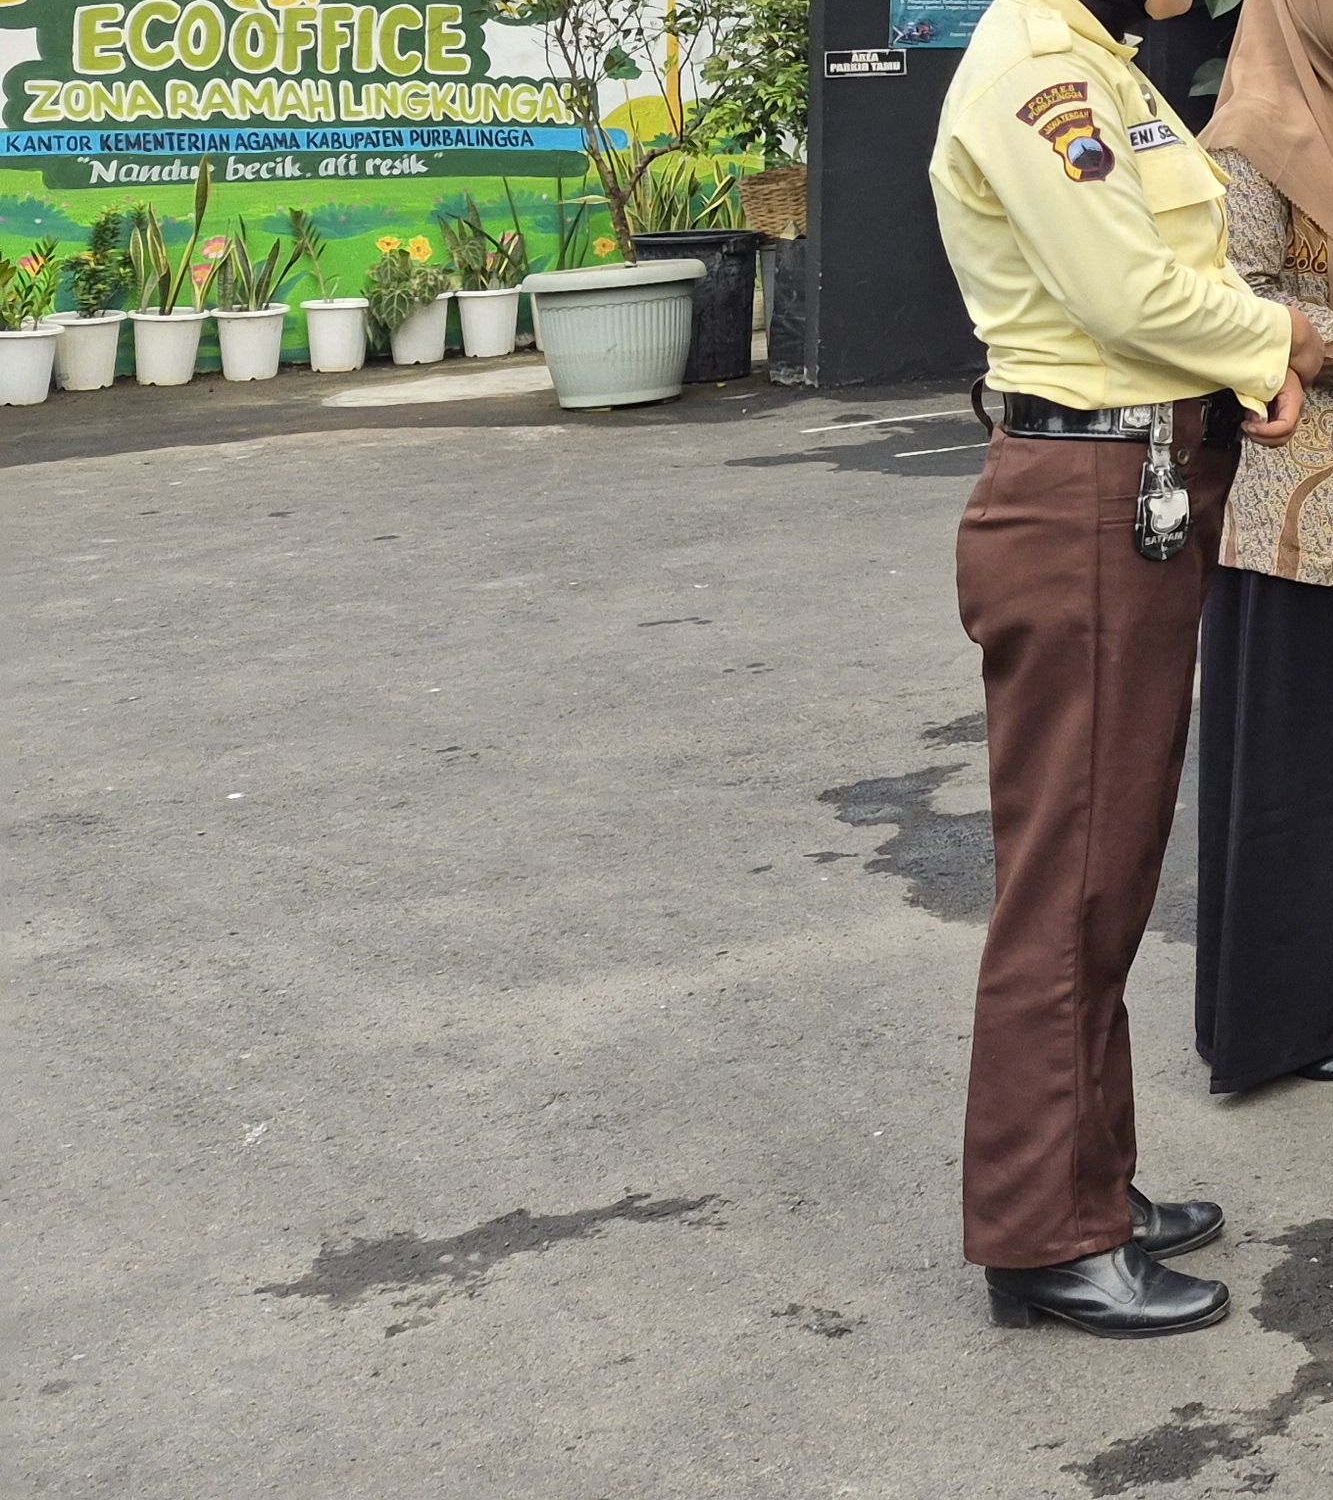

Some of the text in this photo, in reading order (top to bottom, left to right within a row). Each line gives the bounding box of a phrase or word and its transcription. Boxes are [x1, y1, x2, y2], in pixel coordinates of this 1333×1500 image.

[830, 61, 901, 73] PARKIR TAMU
[24, 79, 164, 122] ZONA
[166, 78, 335, 122] RAMAH
[1028, 84, 1075, 110] POLRES
[1028, 90, 1084, 121] PURBALINGGA
[6, 128, 535, 152] KANTOR KEMENTERIAN AGAMA KABUPATEN PURBALINGGA
[1130, 128, 1154, 147] ENI
[318, 153, 357, 178] ati
